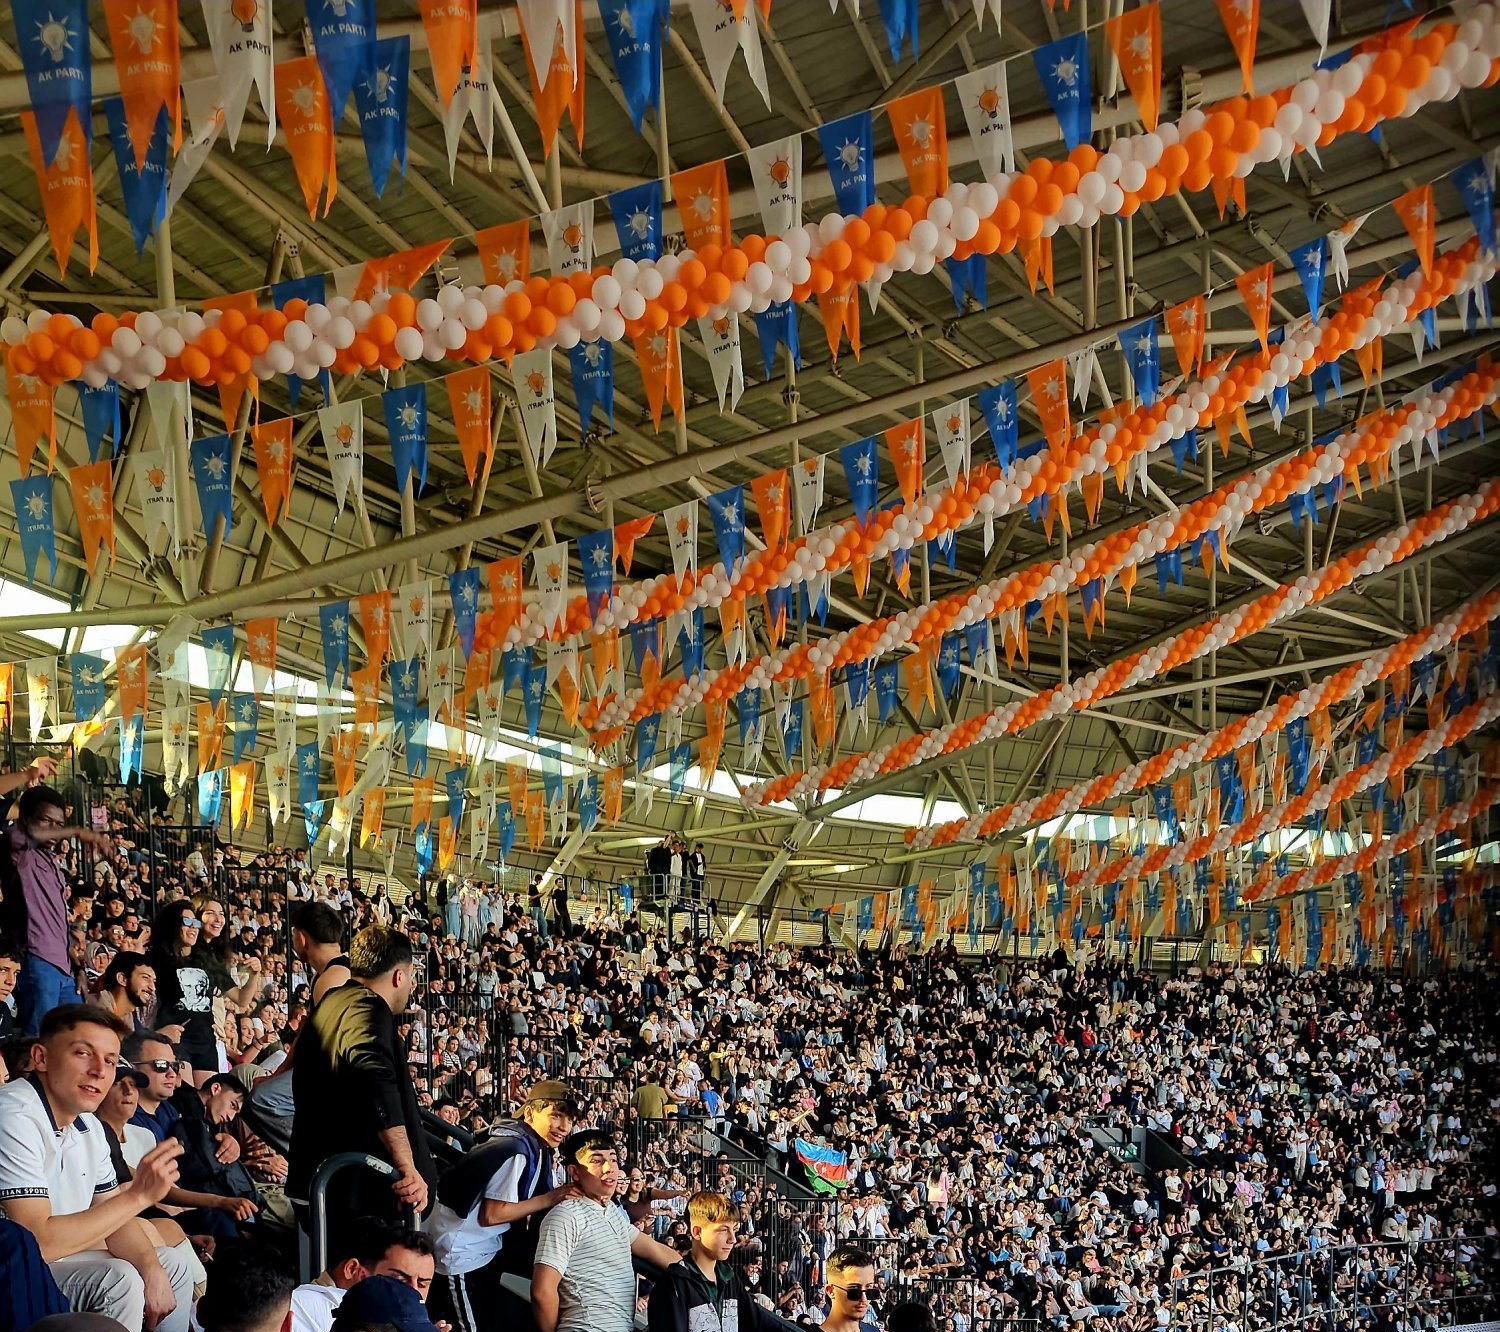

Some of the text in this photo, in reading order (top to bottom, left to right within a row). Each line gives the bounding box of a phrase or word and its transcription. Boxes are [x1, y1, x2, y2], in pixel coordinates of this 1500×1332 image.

[430, 7, 446, 19] AK
[320, 24, 336, 37] AK
[714, 21, 727, 33] AK
[229, 40, 242, 55] AK
[618, 47, 632, 58] AK
[127, 64, 141, 76] AK
[38, 69, 53, 84] AK
[364, 107, 377, 121] AK
[980, 126, 991, 136] AK
[124, 160, 163, 174] AK ARTI
[841, 179, 852, 190] AK
[769, 198, 780, 207] AK
[629, 246, 641, 256] AK
[561, 259, 572, 270] AK
